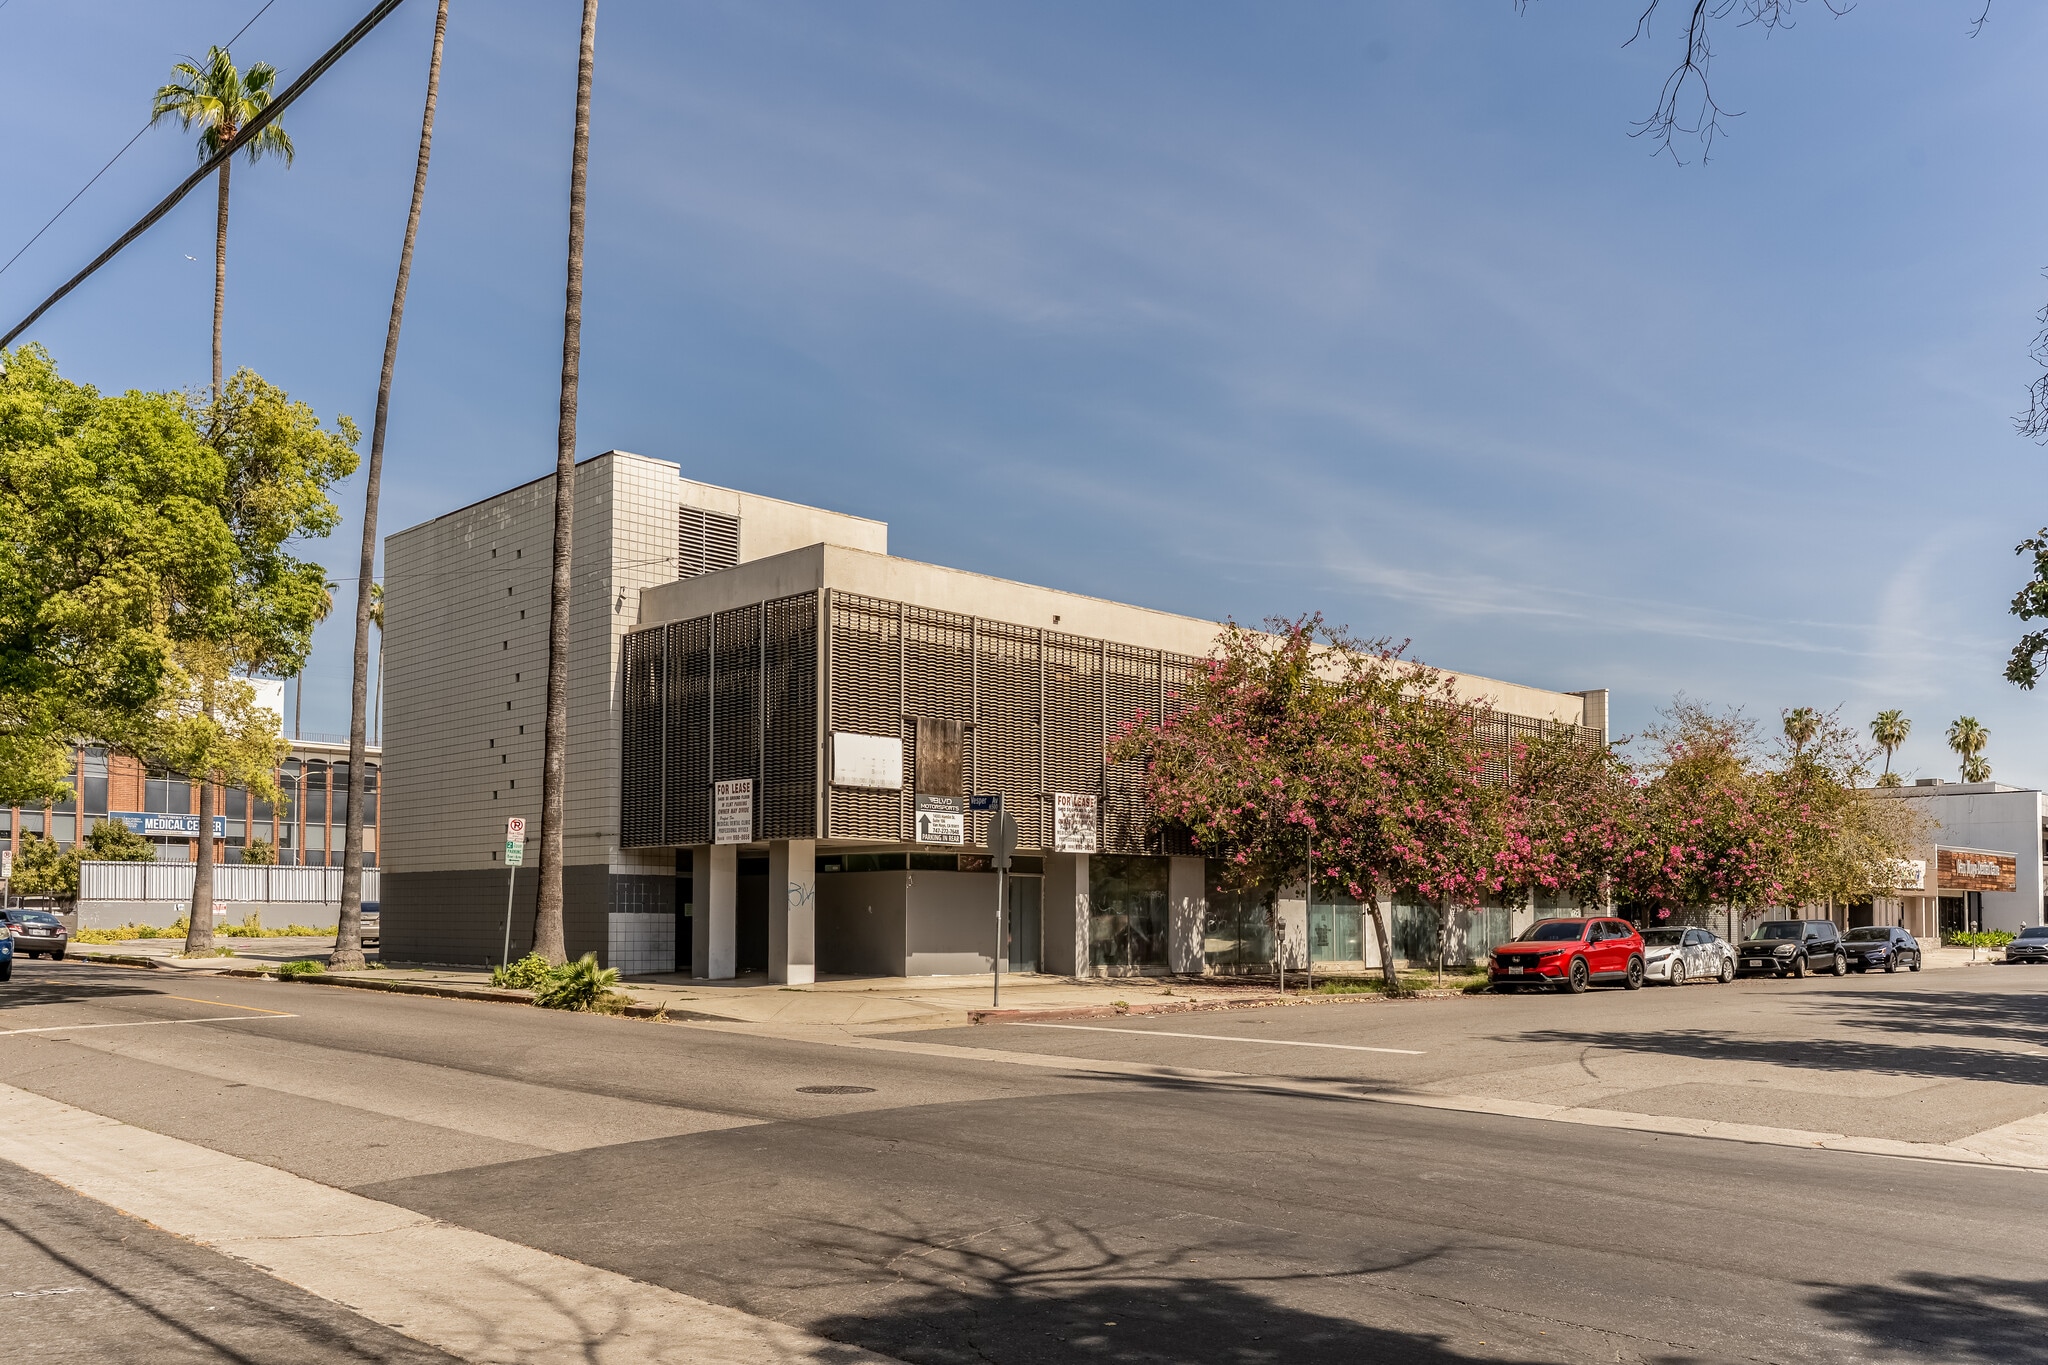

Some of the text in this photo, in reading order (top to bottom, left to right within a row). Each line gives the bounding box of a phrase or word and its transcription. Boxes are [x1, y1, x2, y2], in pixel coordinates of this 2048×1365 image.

[718, 783, 750, 795] FOR LEASE
[971, 796, 987, 806] Vesper
[1058, 796, 1094, 807] FOR LEASE
[921, 803, 959, 811] MOTORSPORTS
[144, 818, 186, 831] MEDICAL
[187, 820, 222, 832] CEER
